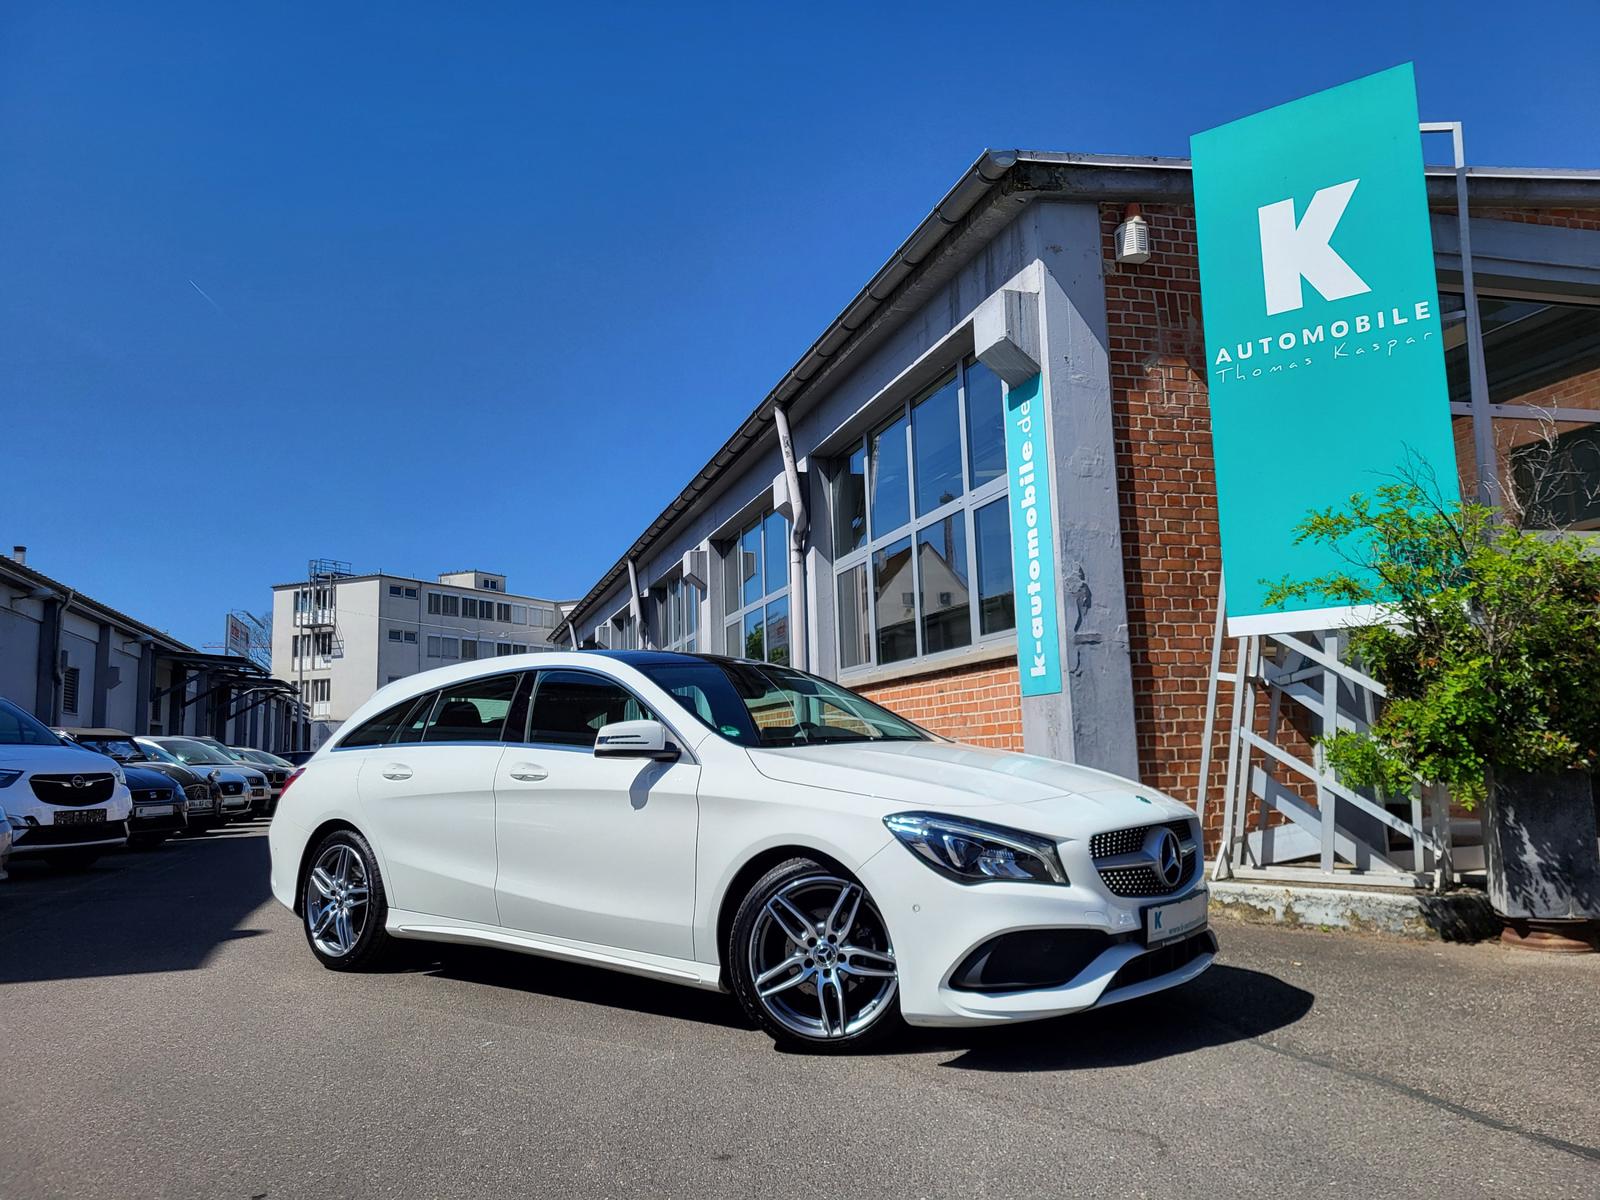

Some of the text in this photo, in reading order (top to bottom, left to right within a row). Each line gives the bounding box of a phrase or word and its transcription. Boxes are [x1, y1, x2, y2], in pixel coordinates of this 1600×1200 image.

[1258, 178, 1372, 316] K
[1215, 301, 1431, 365] AUTOMOBILE
[1216, 332, 1433, 383] Thomas Kaspar
[1017, 400, 1046, 678] k-automobile.de
[1154, 911, 1162, 930] K
